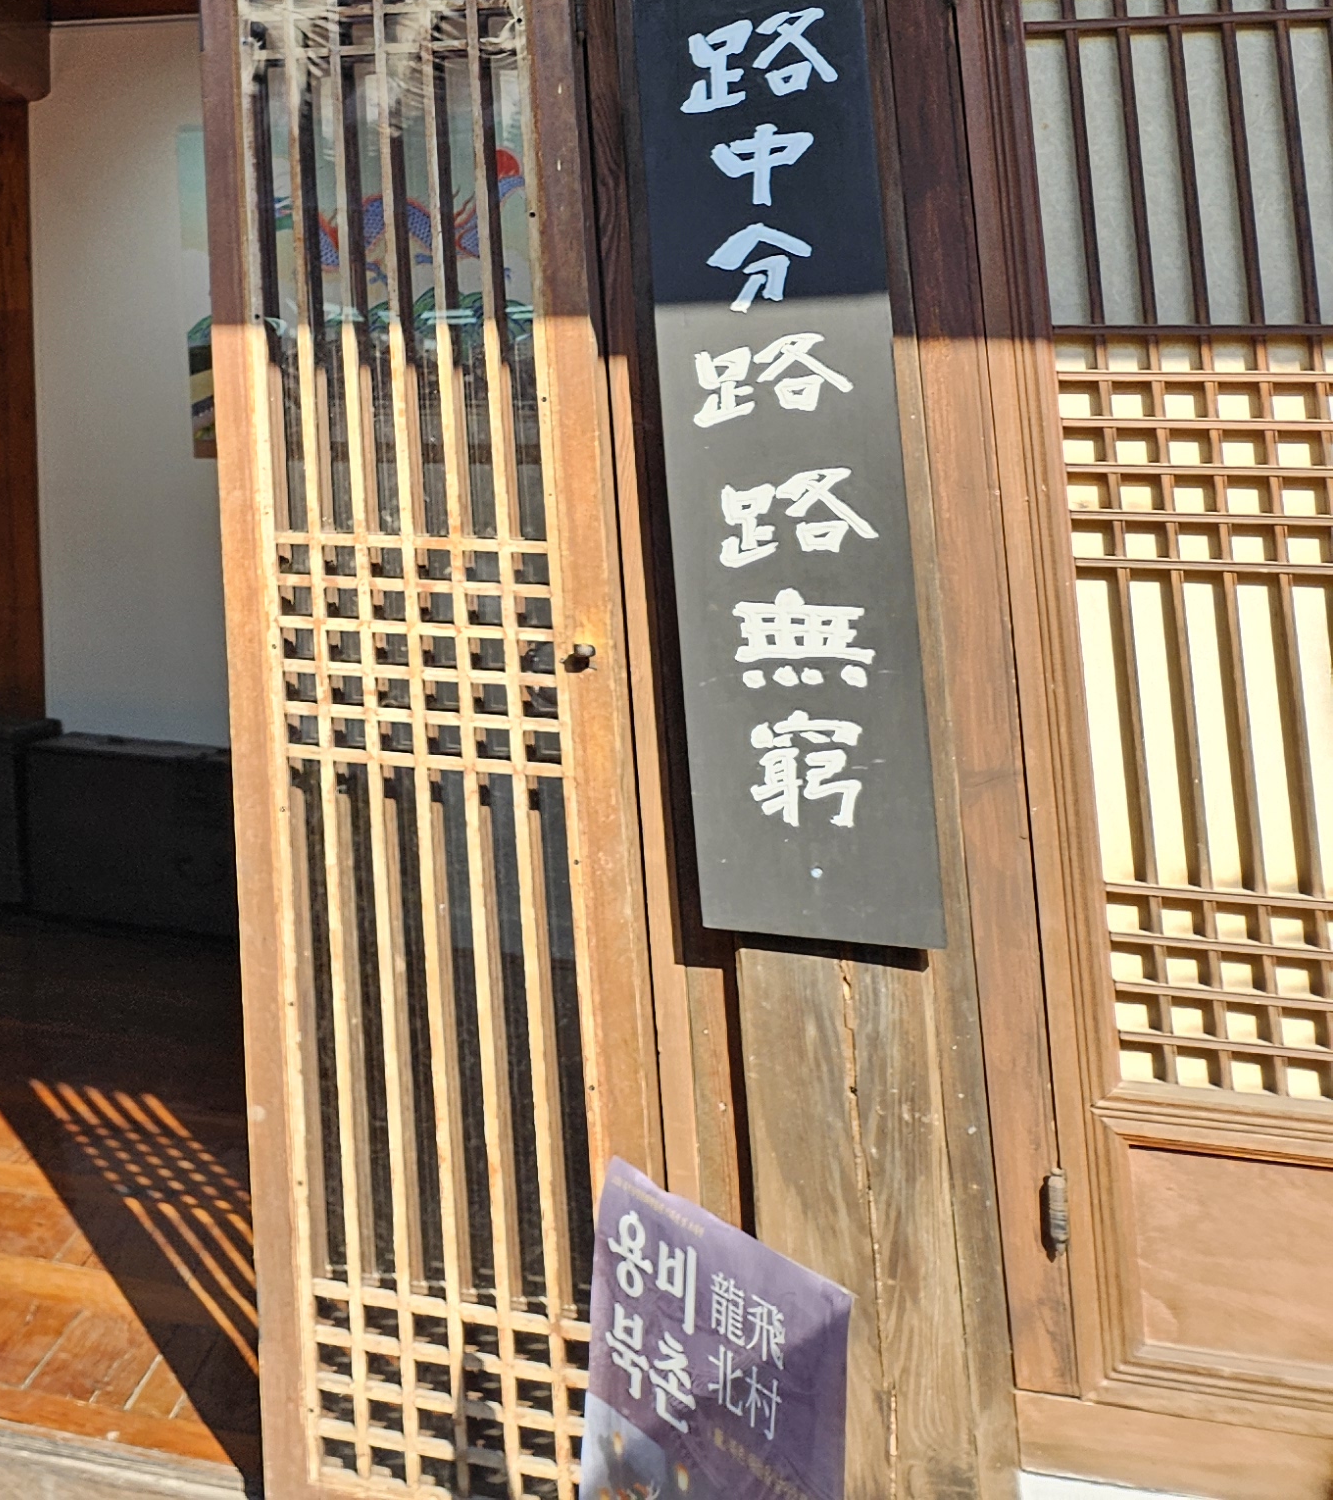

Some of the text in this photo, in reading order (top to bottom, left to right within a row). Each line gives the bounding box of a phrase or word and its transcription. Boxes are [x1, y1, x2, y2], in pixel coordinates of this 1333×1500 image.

[608, 1210, 697, 1336] 용비
[710, 1272, 786, 1371] 龍飛
[606, 1302, 696, 1434] 북촌
[708, 1344, 782, 1441] 北村
